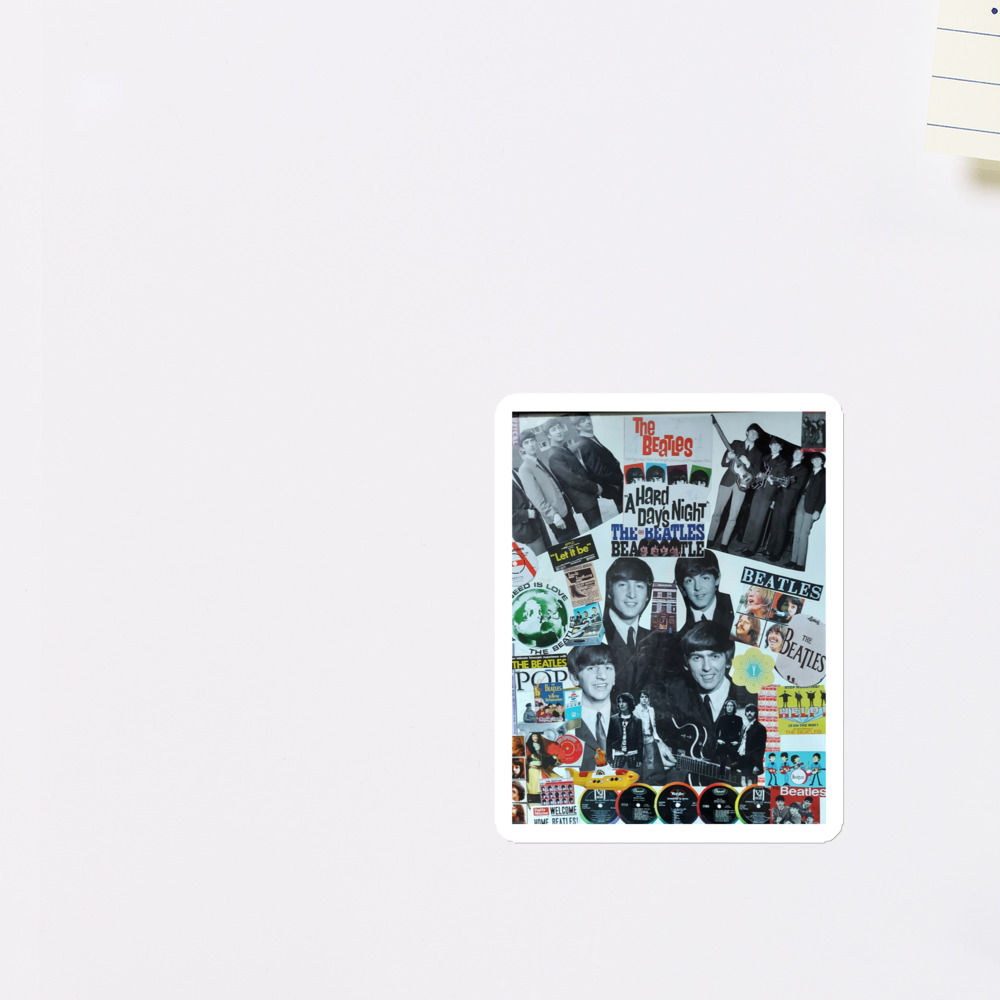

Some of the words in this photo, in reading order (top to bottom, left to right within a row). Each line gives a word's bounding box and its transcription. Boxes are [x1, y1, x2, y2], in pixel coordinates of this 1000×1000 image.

[632, 416, 656, 436] The
[611, 523, 638, 541] THE
[644, 523, 705, 541] BEATLES
[546, 583, 569, 601] LOVE
[742, 567, 823, 600] BEATLES
[529, 647, 550, 655] THE
[780, 627, 826, 673] BEATLES
[512, 660, 530, 670] THE
[530, 658, 567, 669] BEATLES
[515, 670, 568, 691] POP
[780, 786, 827, 797] Beatles
[550, 805, 577, 815] WELCOME
